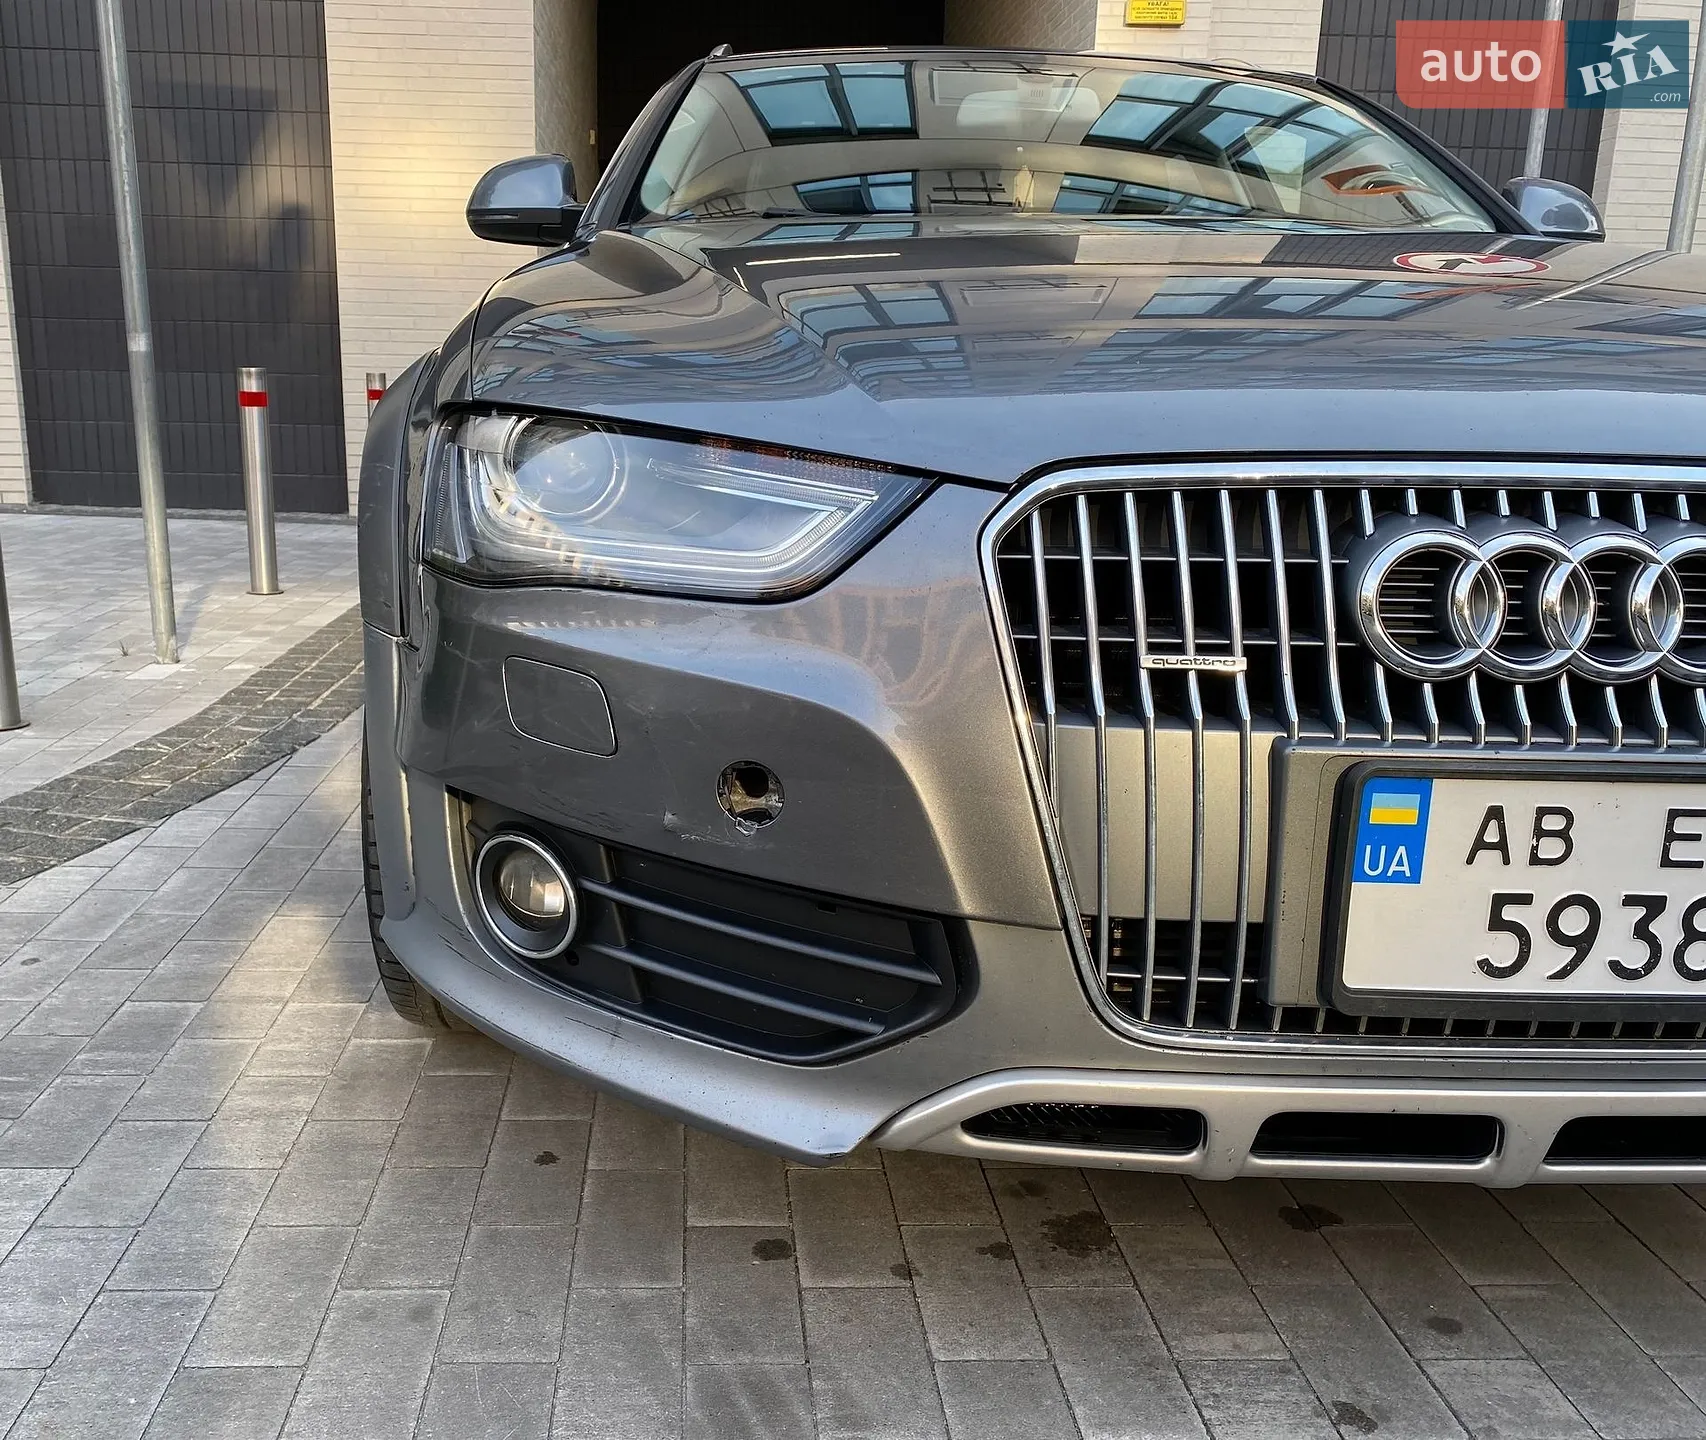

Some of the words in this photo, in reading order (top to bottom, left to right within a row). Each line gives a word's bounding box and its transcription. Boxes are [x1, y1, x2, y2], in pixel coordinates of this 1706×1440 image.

[1152, 657, 1236, 667] quattro
[1465, 804, 1575, 867] AB
[1363, 844, 1411, 878] UA
[1476, 892, 1706, 983] 5938
